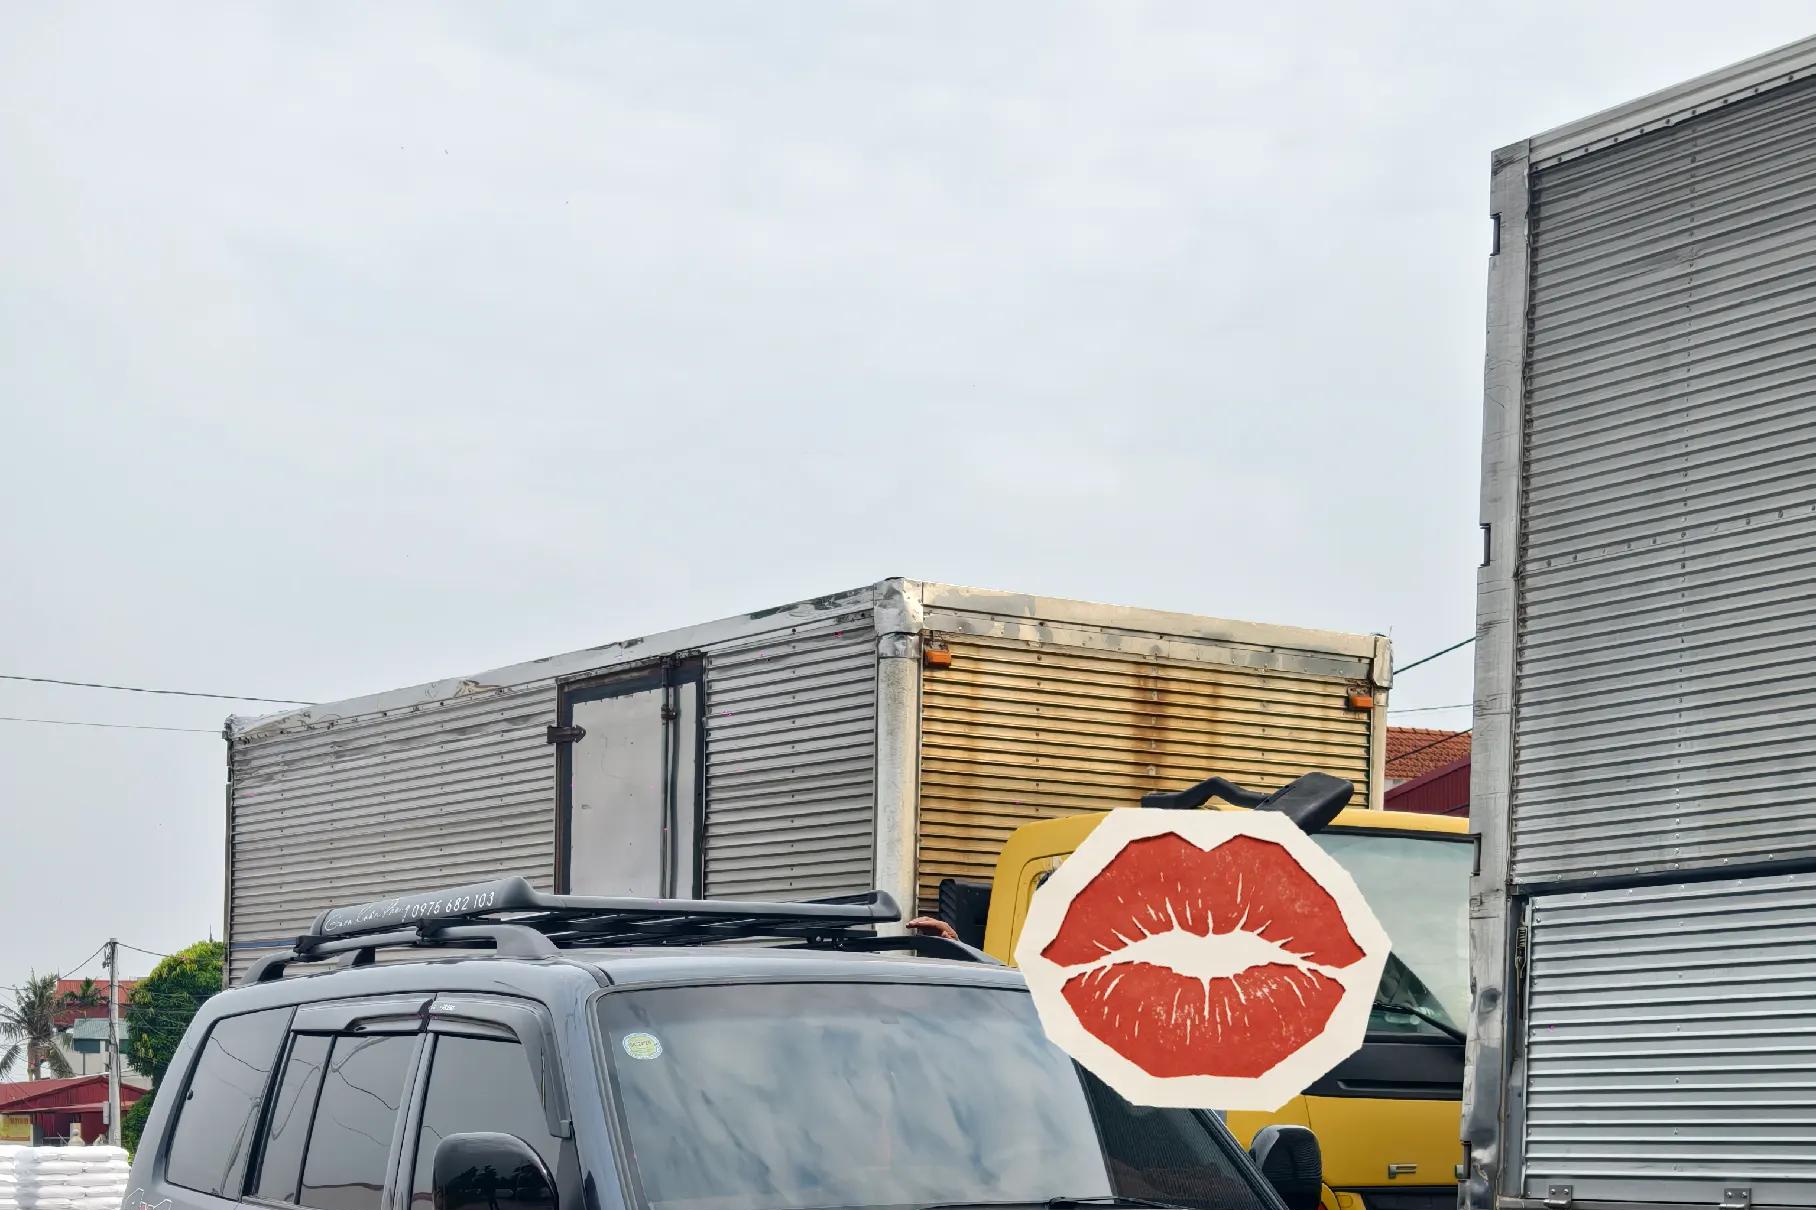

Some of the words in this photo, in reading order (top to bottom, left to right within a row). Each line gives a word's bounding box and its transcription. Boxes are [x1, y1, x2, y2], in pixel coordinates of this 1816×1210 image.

[410, 900, 441, 919] 0975
[445, 895, 469, 913] 682
[472, 891, 496, 909] 103
